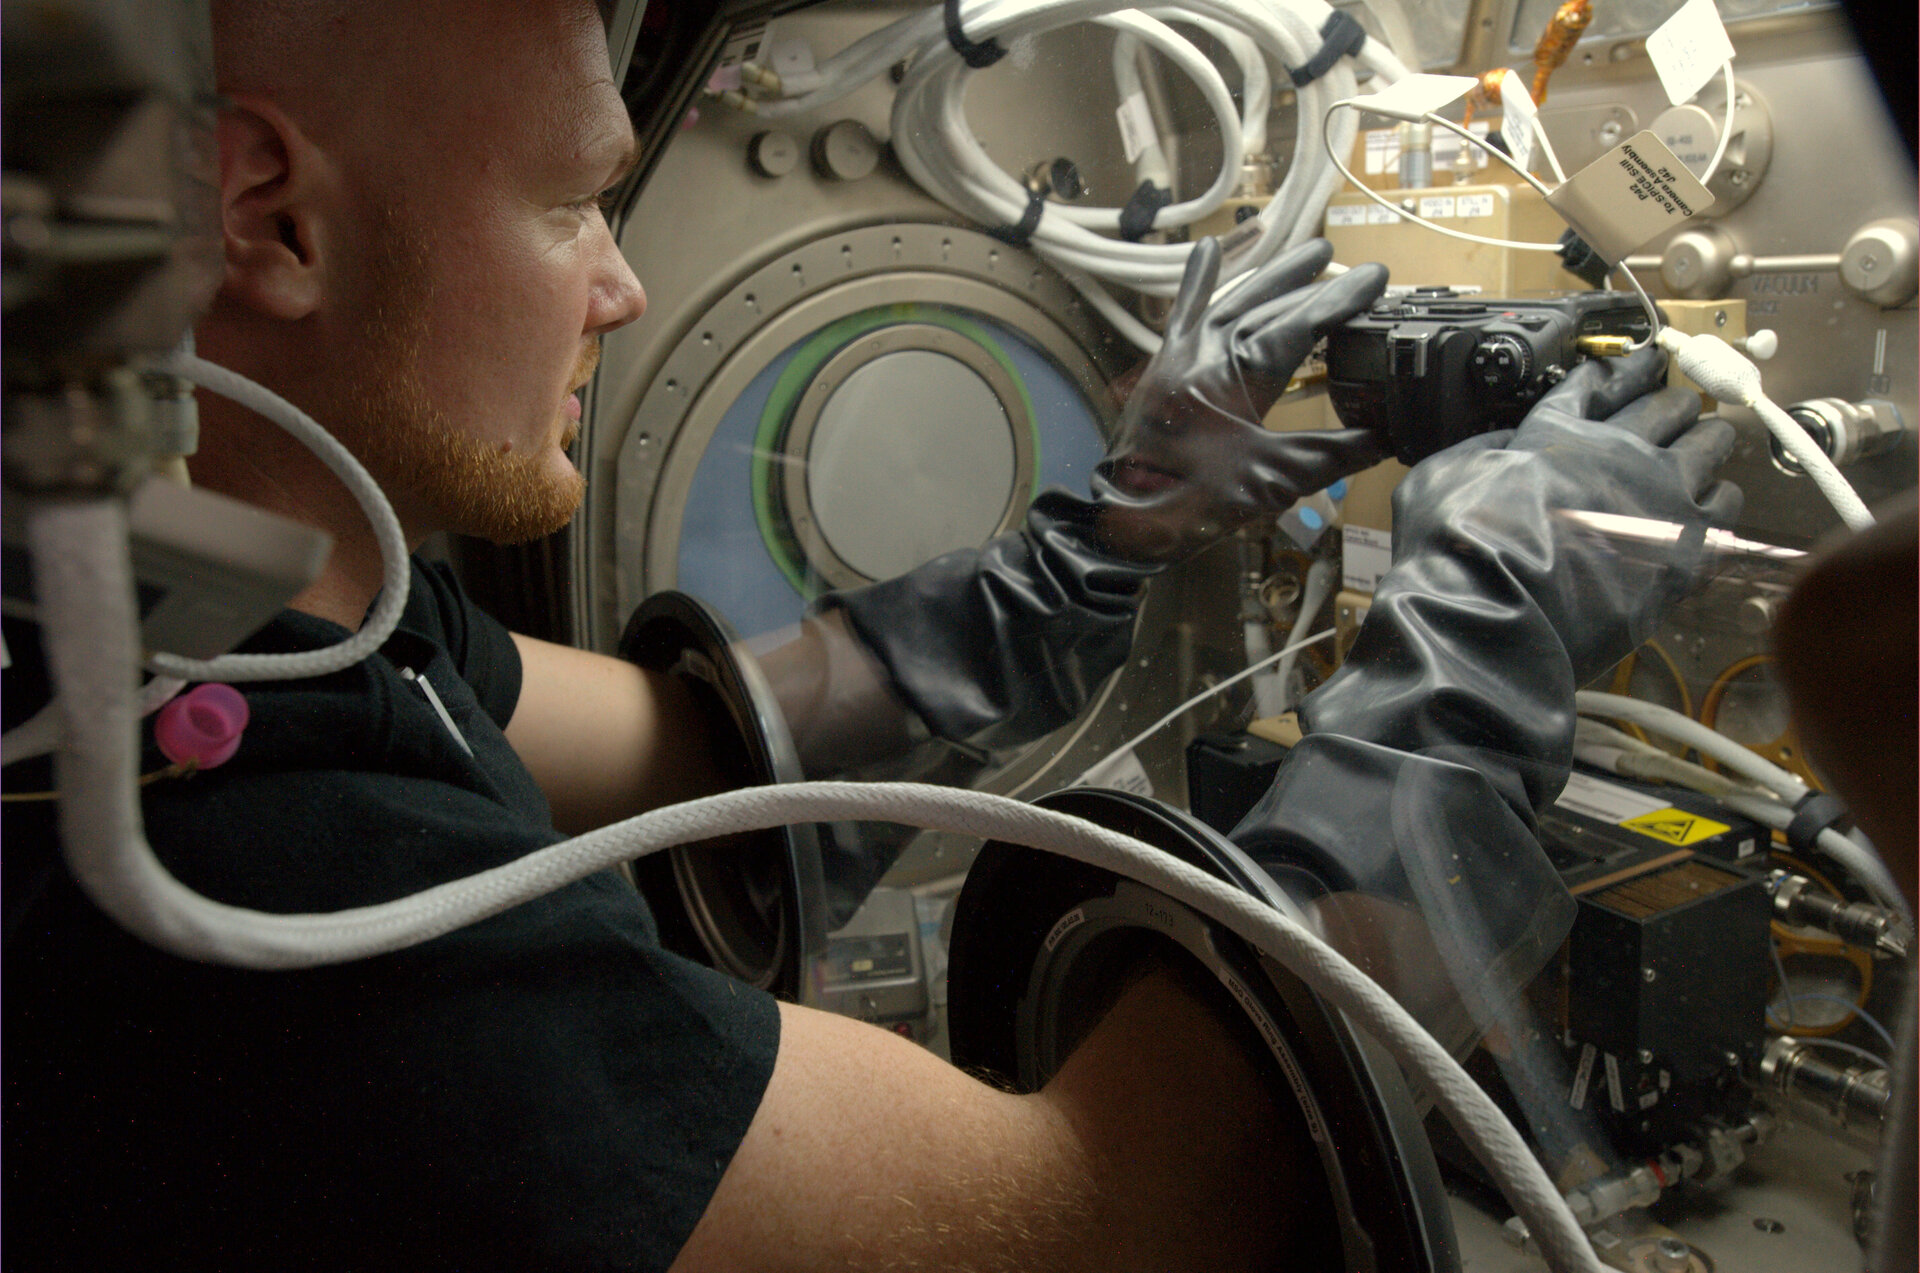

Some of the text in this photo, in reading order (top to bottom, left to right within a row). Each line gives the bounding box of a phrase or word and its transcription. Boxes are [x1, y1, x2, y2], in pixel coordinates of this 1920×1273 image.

[1622, 144, 1663, 184] Assembly
[1657, 166, 1676, 183] J42
[1619, 159, 1676, 215] To SPICE Still
[1629, 183, 1649, 201] P42
[1661, 184, 1693, 217] Camera
[1262, 1021, 1277, 1045] Ring
[1277, 1046, 1302, 1093] Assembly
